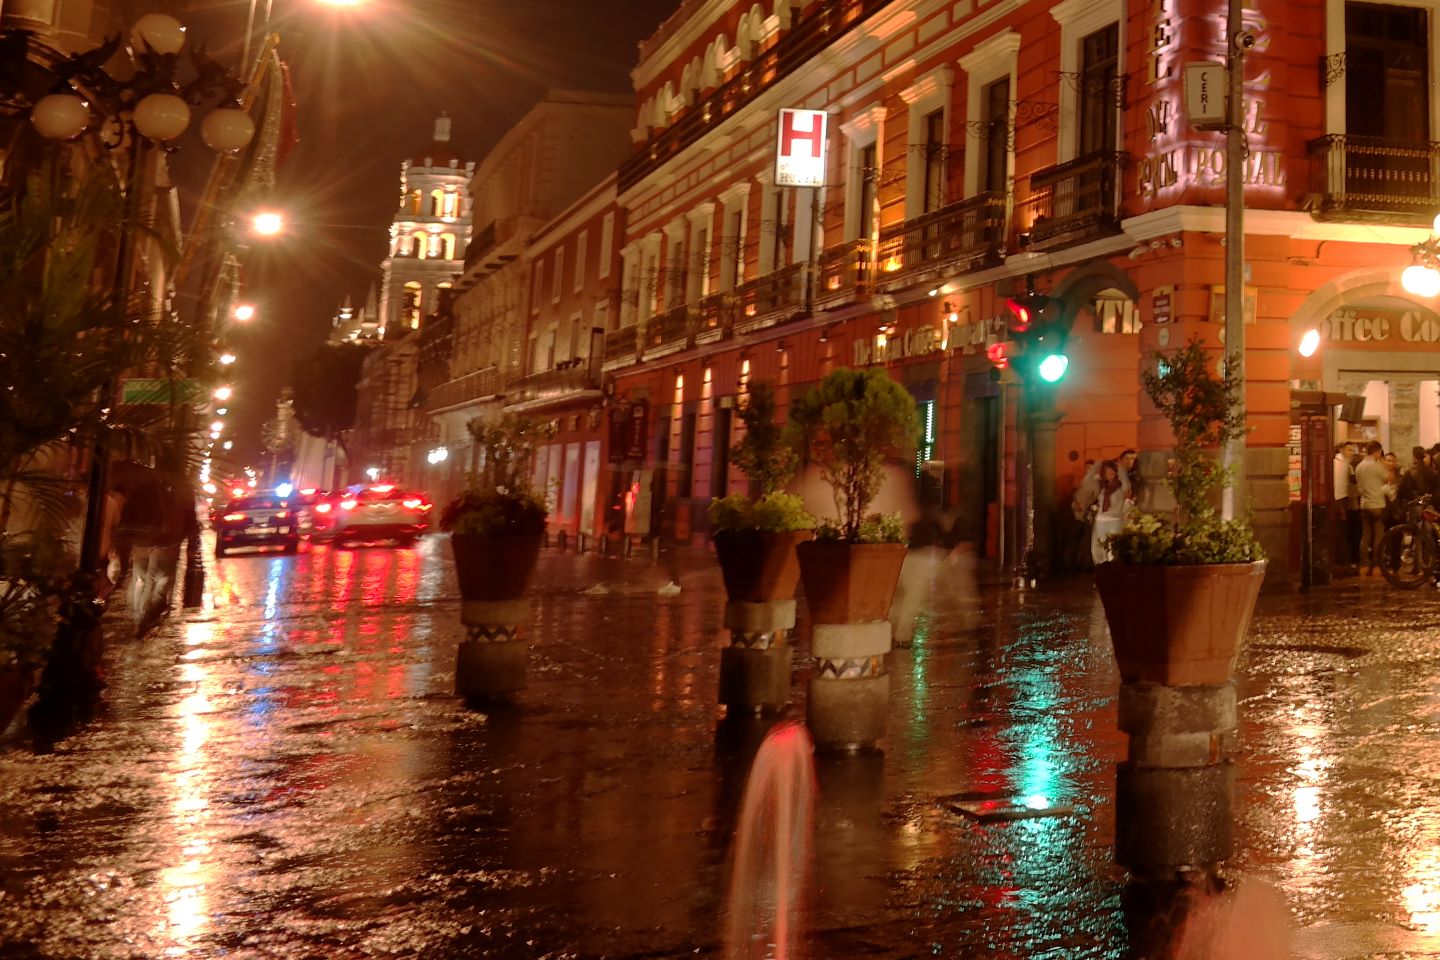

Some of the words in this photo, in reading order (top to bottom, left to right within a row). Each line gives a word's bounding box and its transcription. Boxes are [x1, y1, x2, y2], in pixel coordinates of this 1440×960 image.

[1199, 71, 1209, 115] CERI
[781, 111, 824, 158] H
[1195, 146, 1288, 188] POTAL
[1319, 309, 1391, 342] offee
